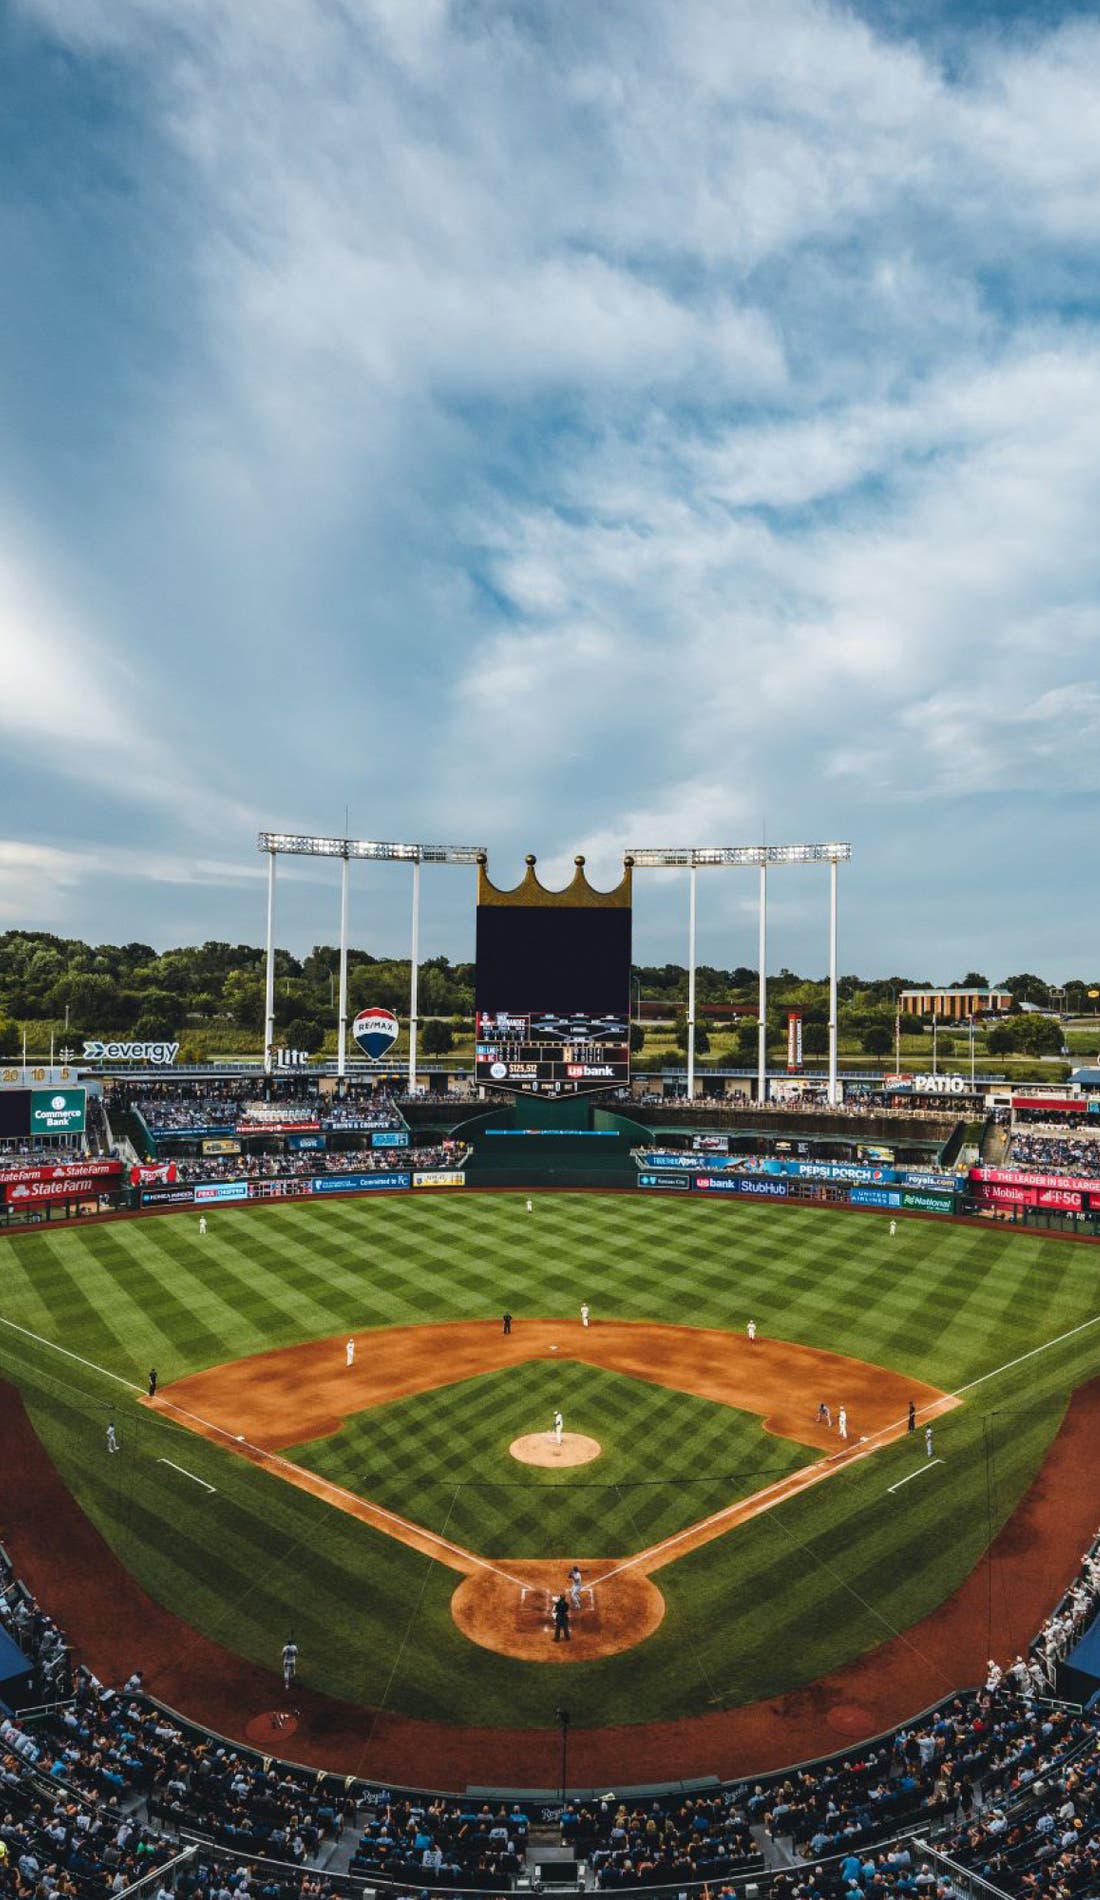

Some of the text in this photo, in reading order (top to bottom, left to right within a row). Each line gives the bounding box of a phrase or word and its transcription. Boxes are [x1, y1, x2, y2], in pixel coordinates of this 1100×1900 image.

[358, 1021, 393, 1032] RE/MAX
[108, 1043, 178, 1063] evergy
[277, 1049, 309, 1069] Lite
[3, 1069, 18, 1082] 20
[32, 1068, 45, 1081] 10
[60, 1067, 69, 1080] 5
[915, 1075, 964, 1093] PATIO
[35, 1110, 81, 1119] Commerce
[47, 1118, 70, 1126] Bank
[799, 1165, 871, 1180] PEPSI PORCH
[360, 1178, 390, 1187] Committed
[908, 1176, 955, 1187] royals.com
[997, 1173, 1013, 1182] THE
[1014, 1174, 1046, 1185] LEADER
[1047, 1177, 1057, 1186] IN
[741, 1180, 786, 1195] StubHub
[992, 1186, 1025, 1200] Mobile
[851, 1196, 887, 1204] AIRLINES
[858, 1191, 887, 1199] UNITED
[1063, 1192, 1082, 1205] 5G
[914, 1197, 951, 1209] National
